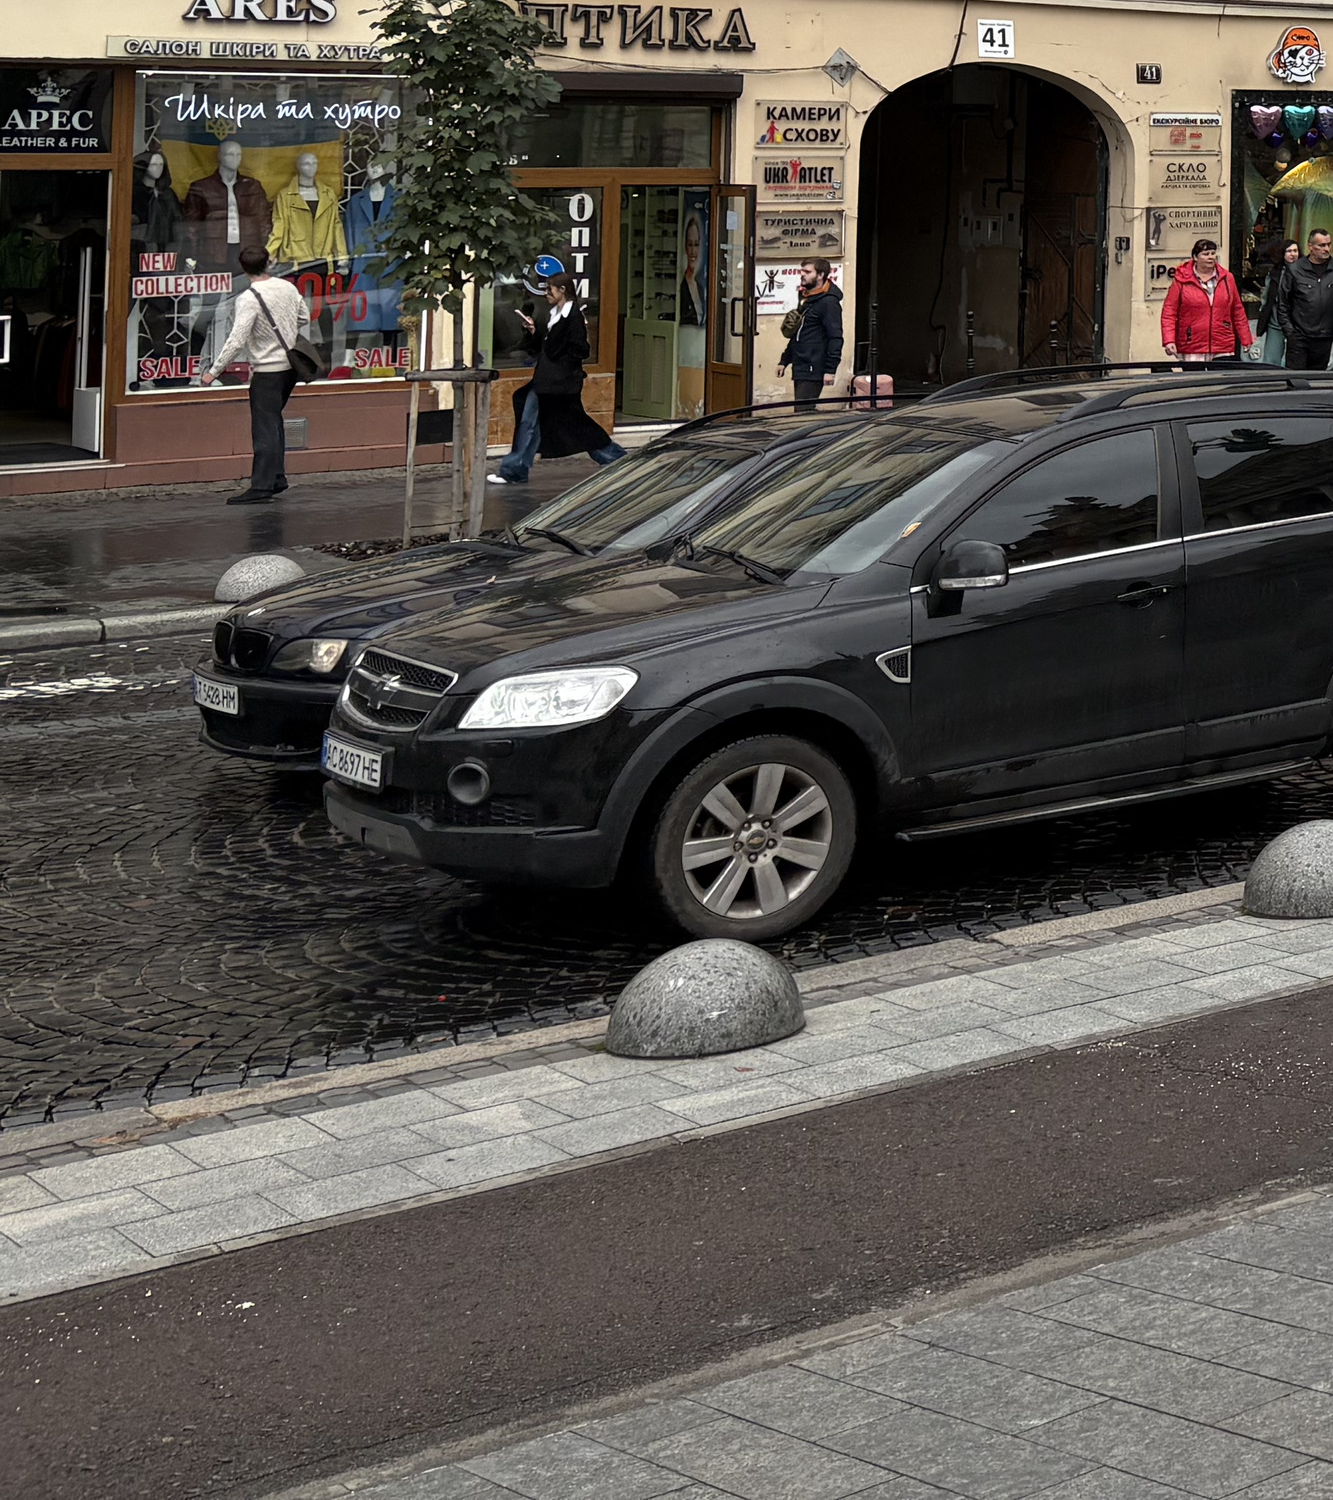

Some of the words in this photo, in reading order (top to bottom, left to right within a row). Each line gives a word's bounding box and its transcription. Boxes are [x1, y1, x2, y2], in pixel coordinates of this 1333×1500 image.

[520, 3, 756, 50] ПТИКА
[982, 27, 1010, 47] 41
[125, 39, 202, 57] САЛОН
[210, 41, 278, 58] ШКІРИ
[286, 43, 311, 59] ТА
[319, 44, 383, 60] ХУТРА
[1143, 66, 1157, 80] 41
[165, 93, 266, 129] Шкіра
[275, 100, 313, 120] та
[324, 100, 401, 129] хутро
[766, 106, 841, 121] КАМЕРИ
[59, 137, 68, 147] &
[71, 138, 99, 148] FUR
[782, 128, 842, 142] СХОВУ
[1166, 162, 1207, 173] СКЛО
[764, 218, 836, 226] ТУРИСТИЧНА
[1168, 210, 1219, 218] СПОРТИВНЕ
[781, 228, 817, 236] ФІРМА
[139, 252, 177, 271] NEW
[568, 193, 594, 311] ОПТИ
[1151, 264, 1177, 279] iPe
[133, 273, 231, 297] COLLECTION
[288, 271, 367, 322] 0%
[139, 356, 201, 380] SALE
[354, 347, 411, 369] SALE
[221, 688, 236, 710] HM
[326, 742, 338, 769] AC
[338, 749, 361, 777] 8697
[362, 755, 379, 784] HE
